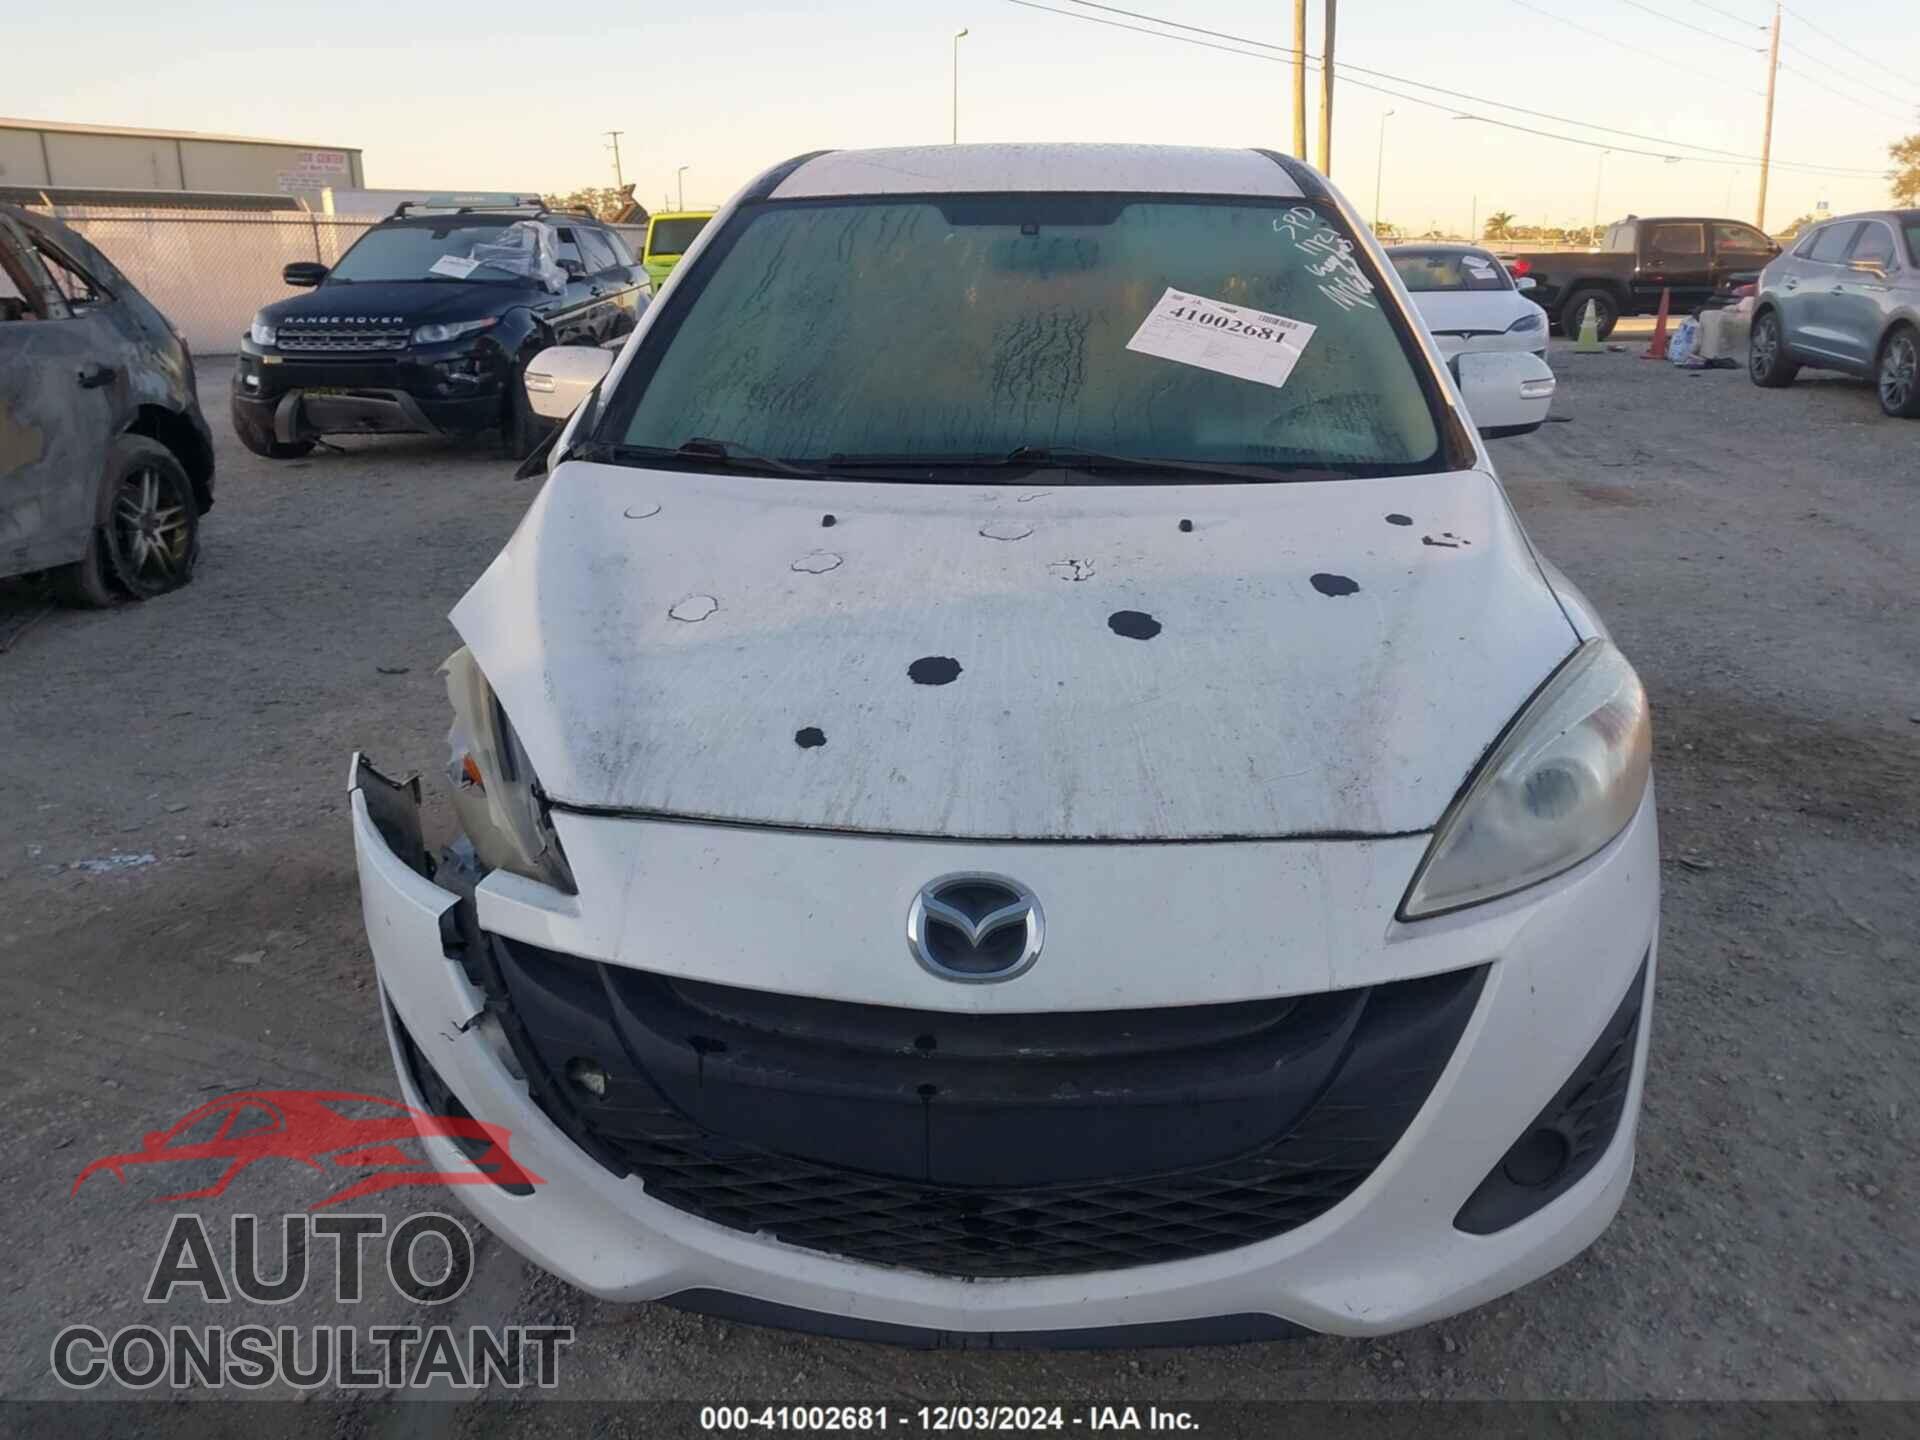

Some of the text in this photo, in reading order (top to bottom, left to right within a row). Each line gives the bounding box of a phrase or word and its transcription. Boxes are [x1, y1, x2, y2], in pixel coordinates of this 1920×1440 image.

[284, 316, 404, 324] RANGE ROVER
[1169, 306, 1287, 343] 41002681
